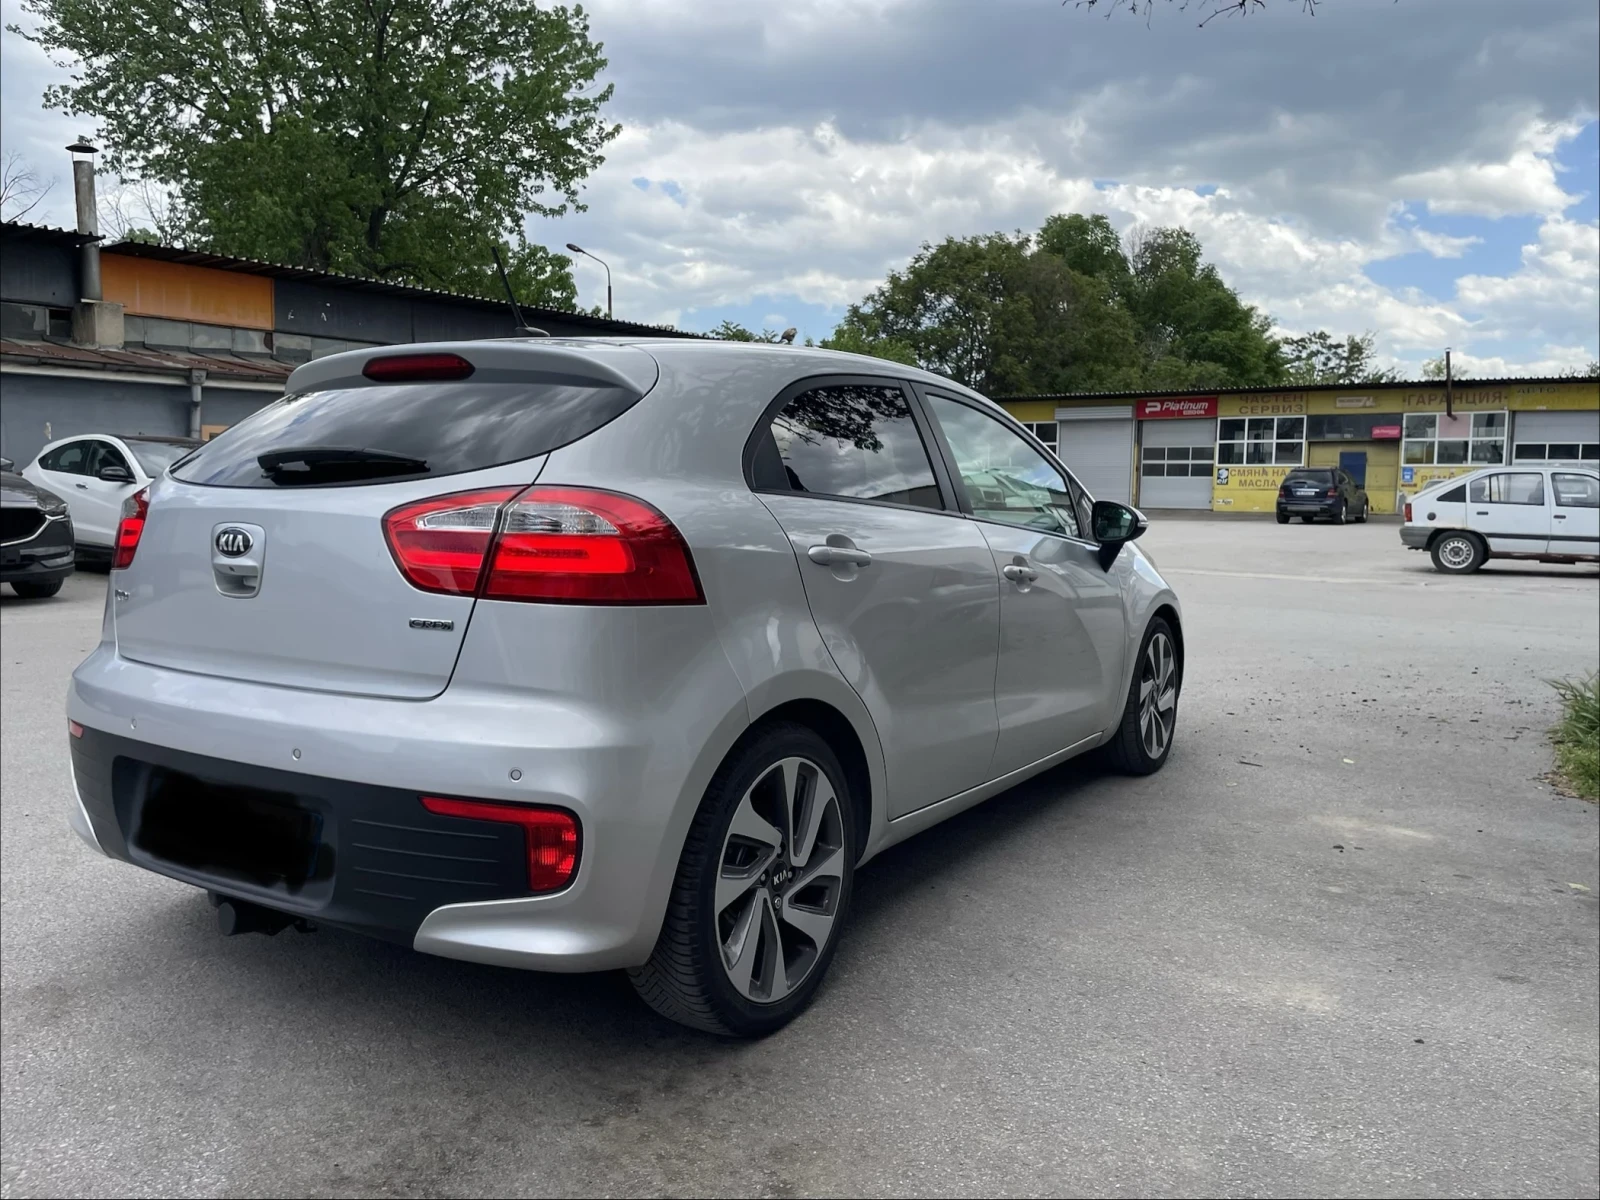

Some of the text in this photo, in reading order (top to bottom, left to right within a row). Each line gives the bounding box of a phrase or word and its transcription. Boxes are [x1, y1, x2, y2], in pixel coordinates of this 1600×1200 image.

[1240, 393, 1304, 404] ЧАСТЕН
[1407, 391, 1503, 406] ГАРАНЦИЯ
[1162, 401, 1208, 411] Platinum
[1239, 404, 1304, 414] СЕРВИЗ
[1230, 468, 1287, 477] СМЯНА НА
[1239, 479, 1277, 487] МАСЛА
[219, 534, 245, 551] KIA
[773, 869, 788, 886] KIA
